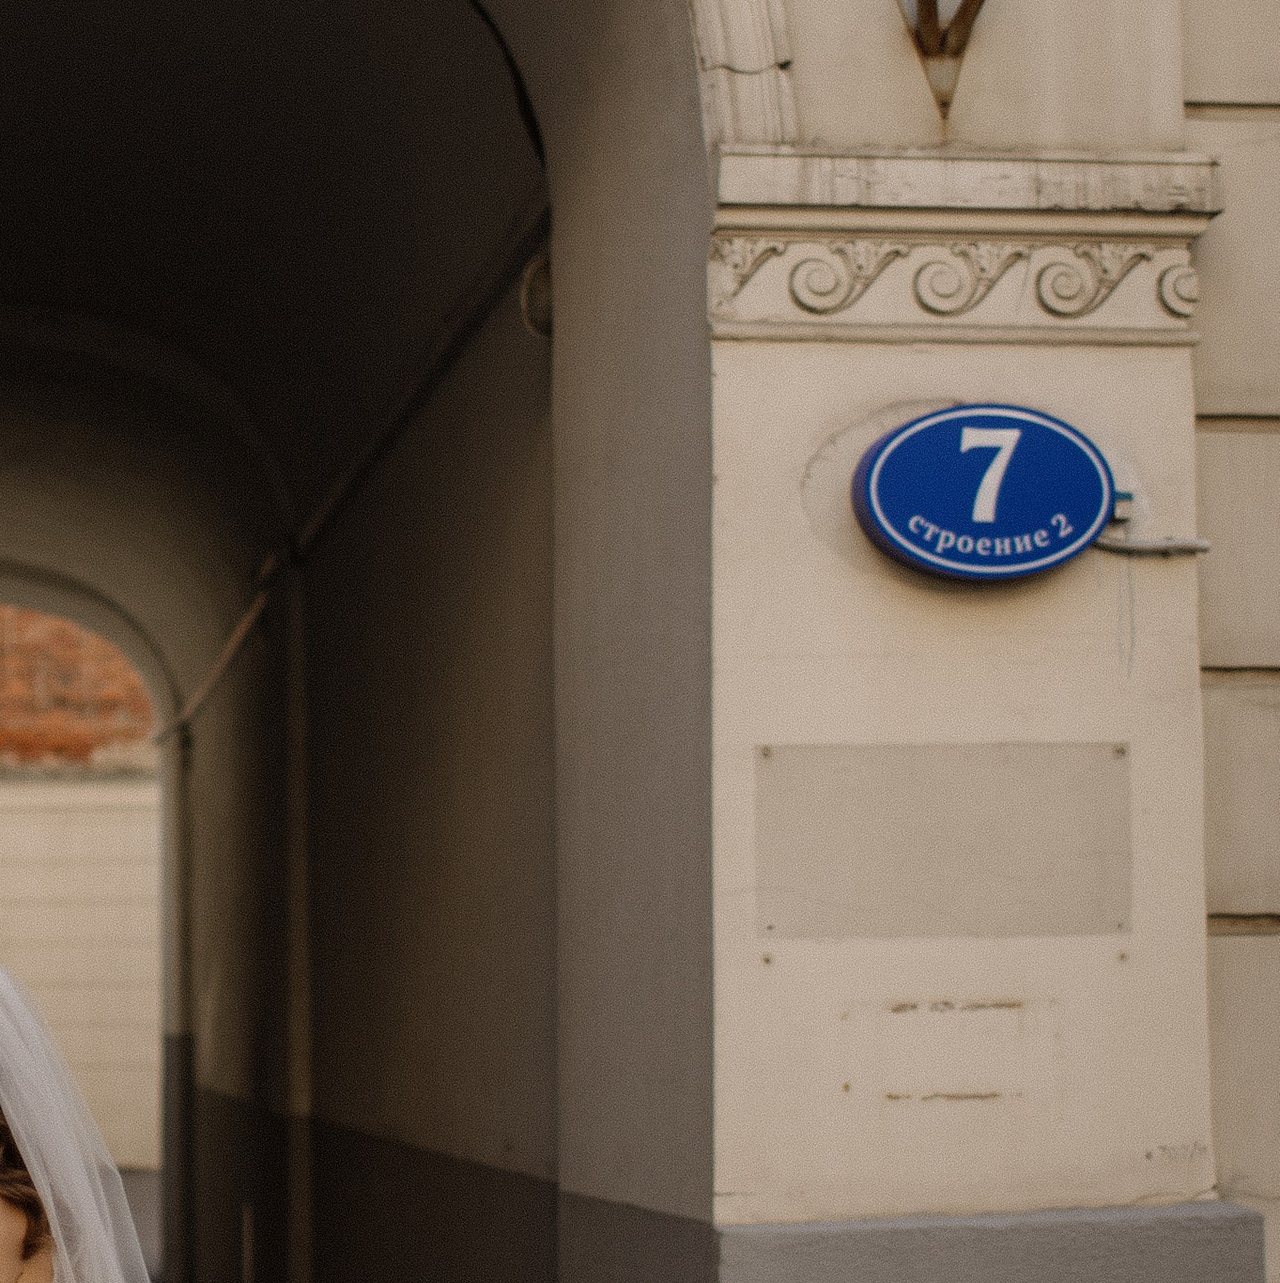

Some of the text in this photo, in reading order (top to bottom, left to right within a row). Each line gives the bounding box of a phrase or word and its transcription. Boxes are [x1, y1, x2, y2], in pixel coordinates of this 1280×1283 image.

[960, 426, 1022, 523] 7
[908, 512, 1074, 556] строение 2
